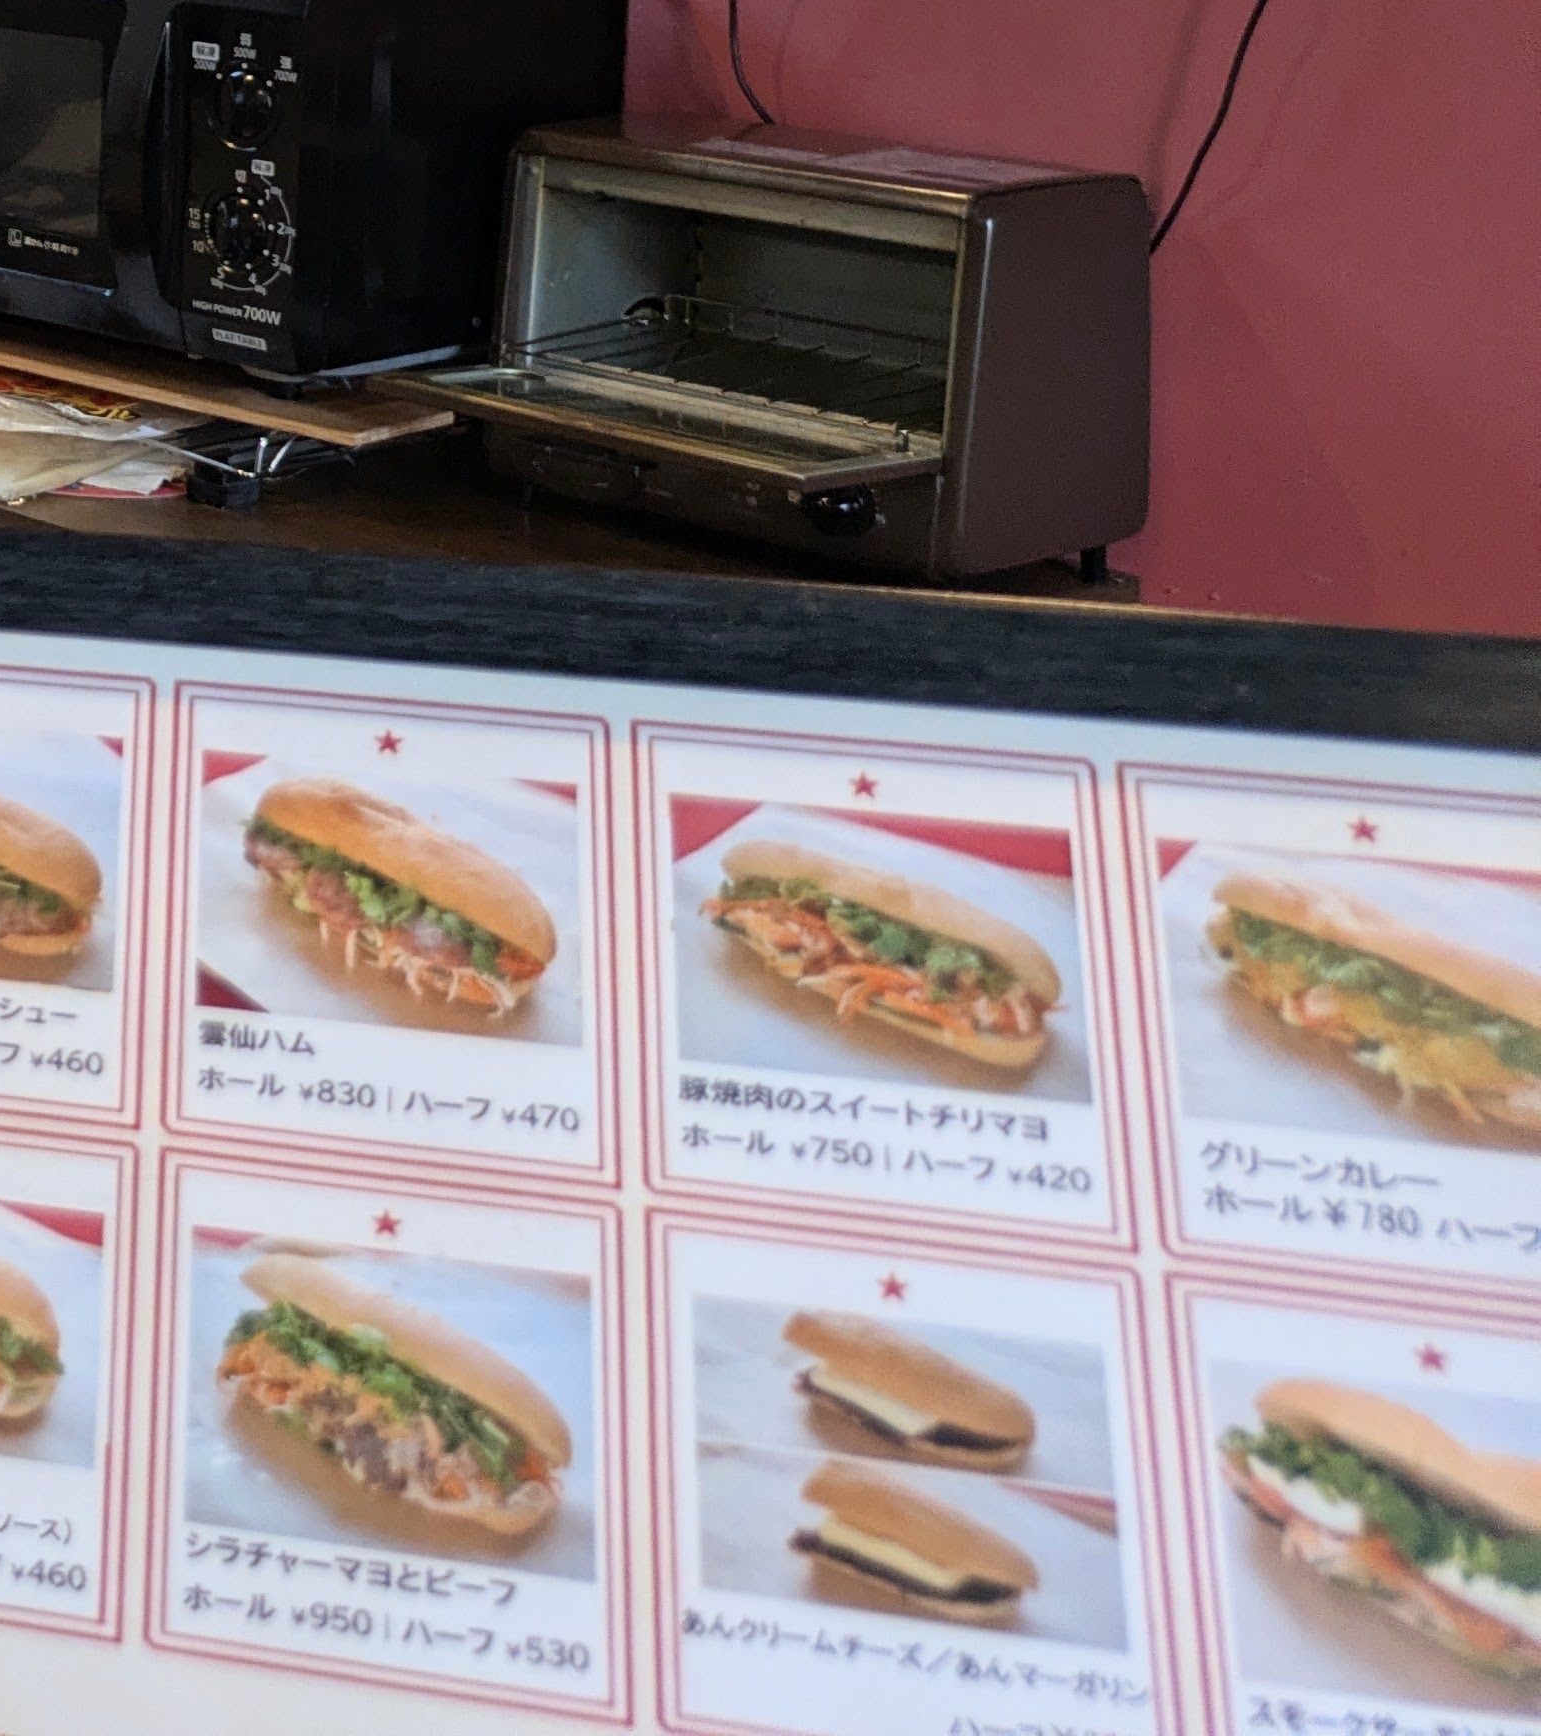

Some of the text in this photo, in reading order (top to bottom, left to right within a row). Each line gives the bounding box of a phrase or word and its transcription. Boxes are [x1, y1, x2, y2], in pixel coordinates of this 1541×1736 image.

[242, 305, 282, 326] 700W
[197, 1066, 285, 1098] ホール
[403, 1091, 492, 1121] ハーフ
[681, 1122, 776, 1156] ホール
[903, 1149, 996, 1181] ハーフ
[1199, 1140, 1441, 1190] グリーンカレー
[1203, 1184, 1314, 1224] ホール
[182, 1582, 275, 1621] ホール
[400, 1618, 495, 1654] ハーフ
